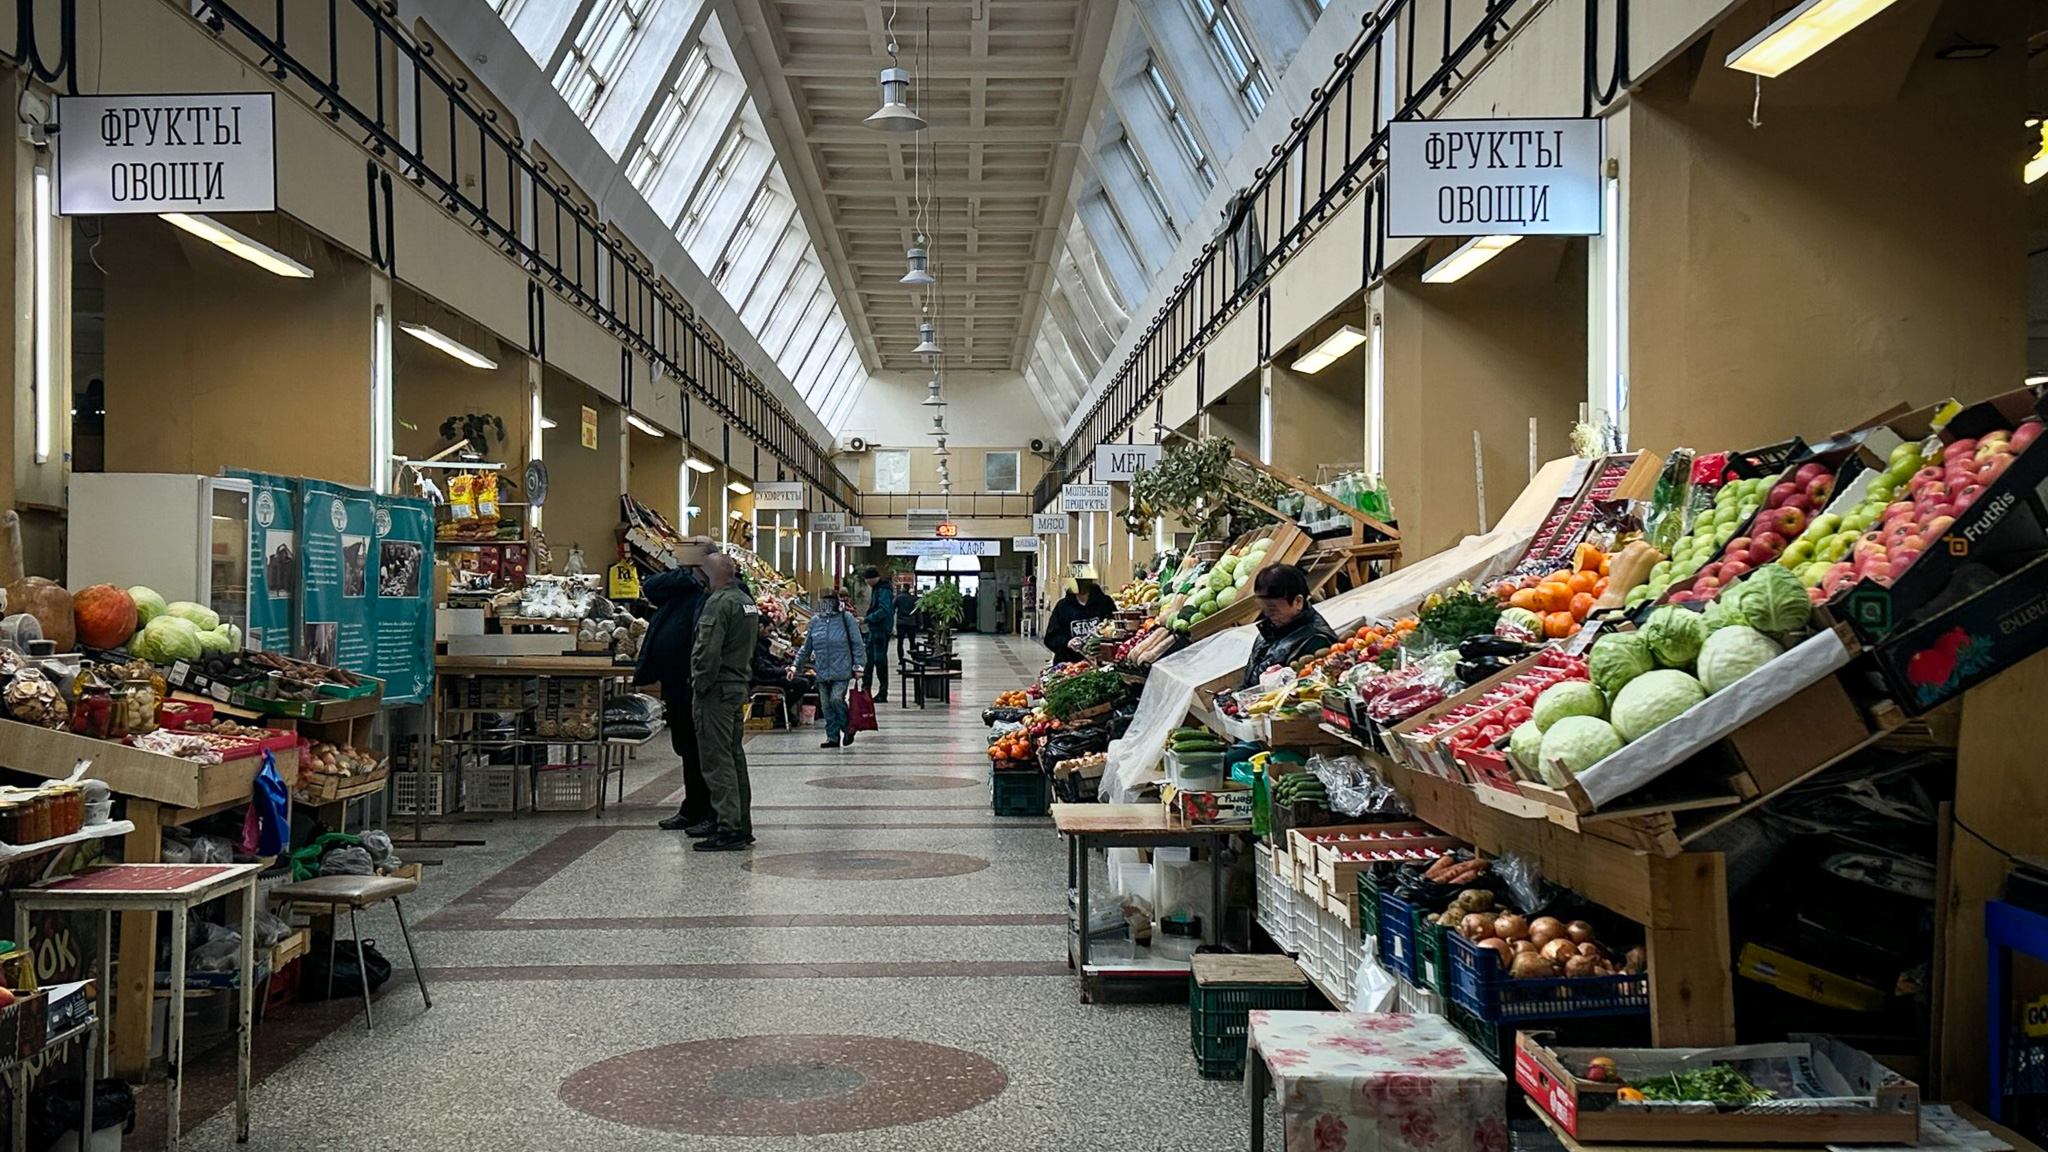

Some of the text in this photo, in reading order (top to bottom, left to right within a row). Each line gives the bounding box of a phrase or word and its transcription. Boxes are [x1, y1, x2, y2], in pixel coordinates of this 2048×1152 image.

[101, 106, 242, 147] ФРУКТЫ
[1425, 130, 1563, 169] ФРУКТЫ
[111, 161, 226, 204] ОВОЩИ
[1438, 185, 1549, 226] ОВОЩИ
[1065, 486, 1109, 497] МОЛОЧНЫЕ
[1065, 499, 1108, 510] ПРОДУКТЫ
[1038, 518, 1064, 530] МЯСО
[1962, 491, 2016, 543] FrutRis
[959, 541, 985, 555] КАФЕ
[1225, 794, 1253, 804] Berry
